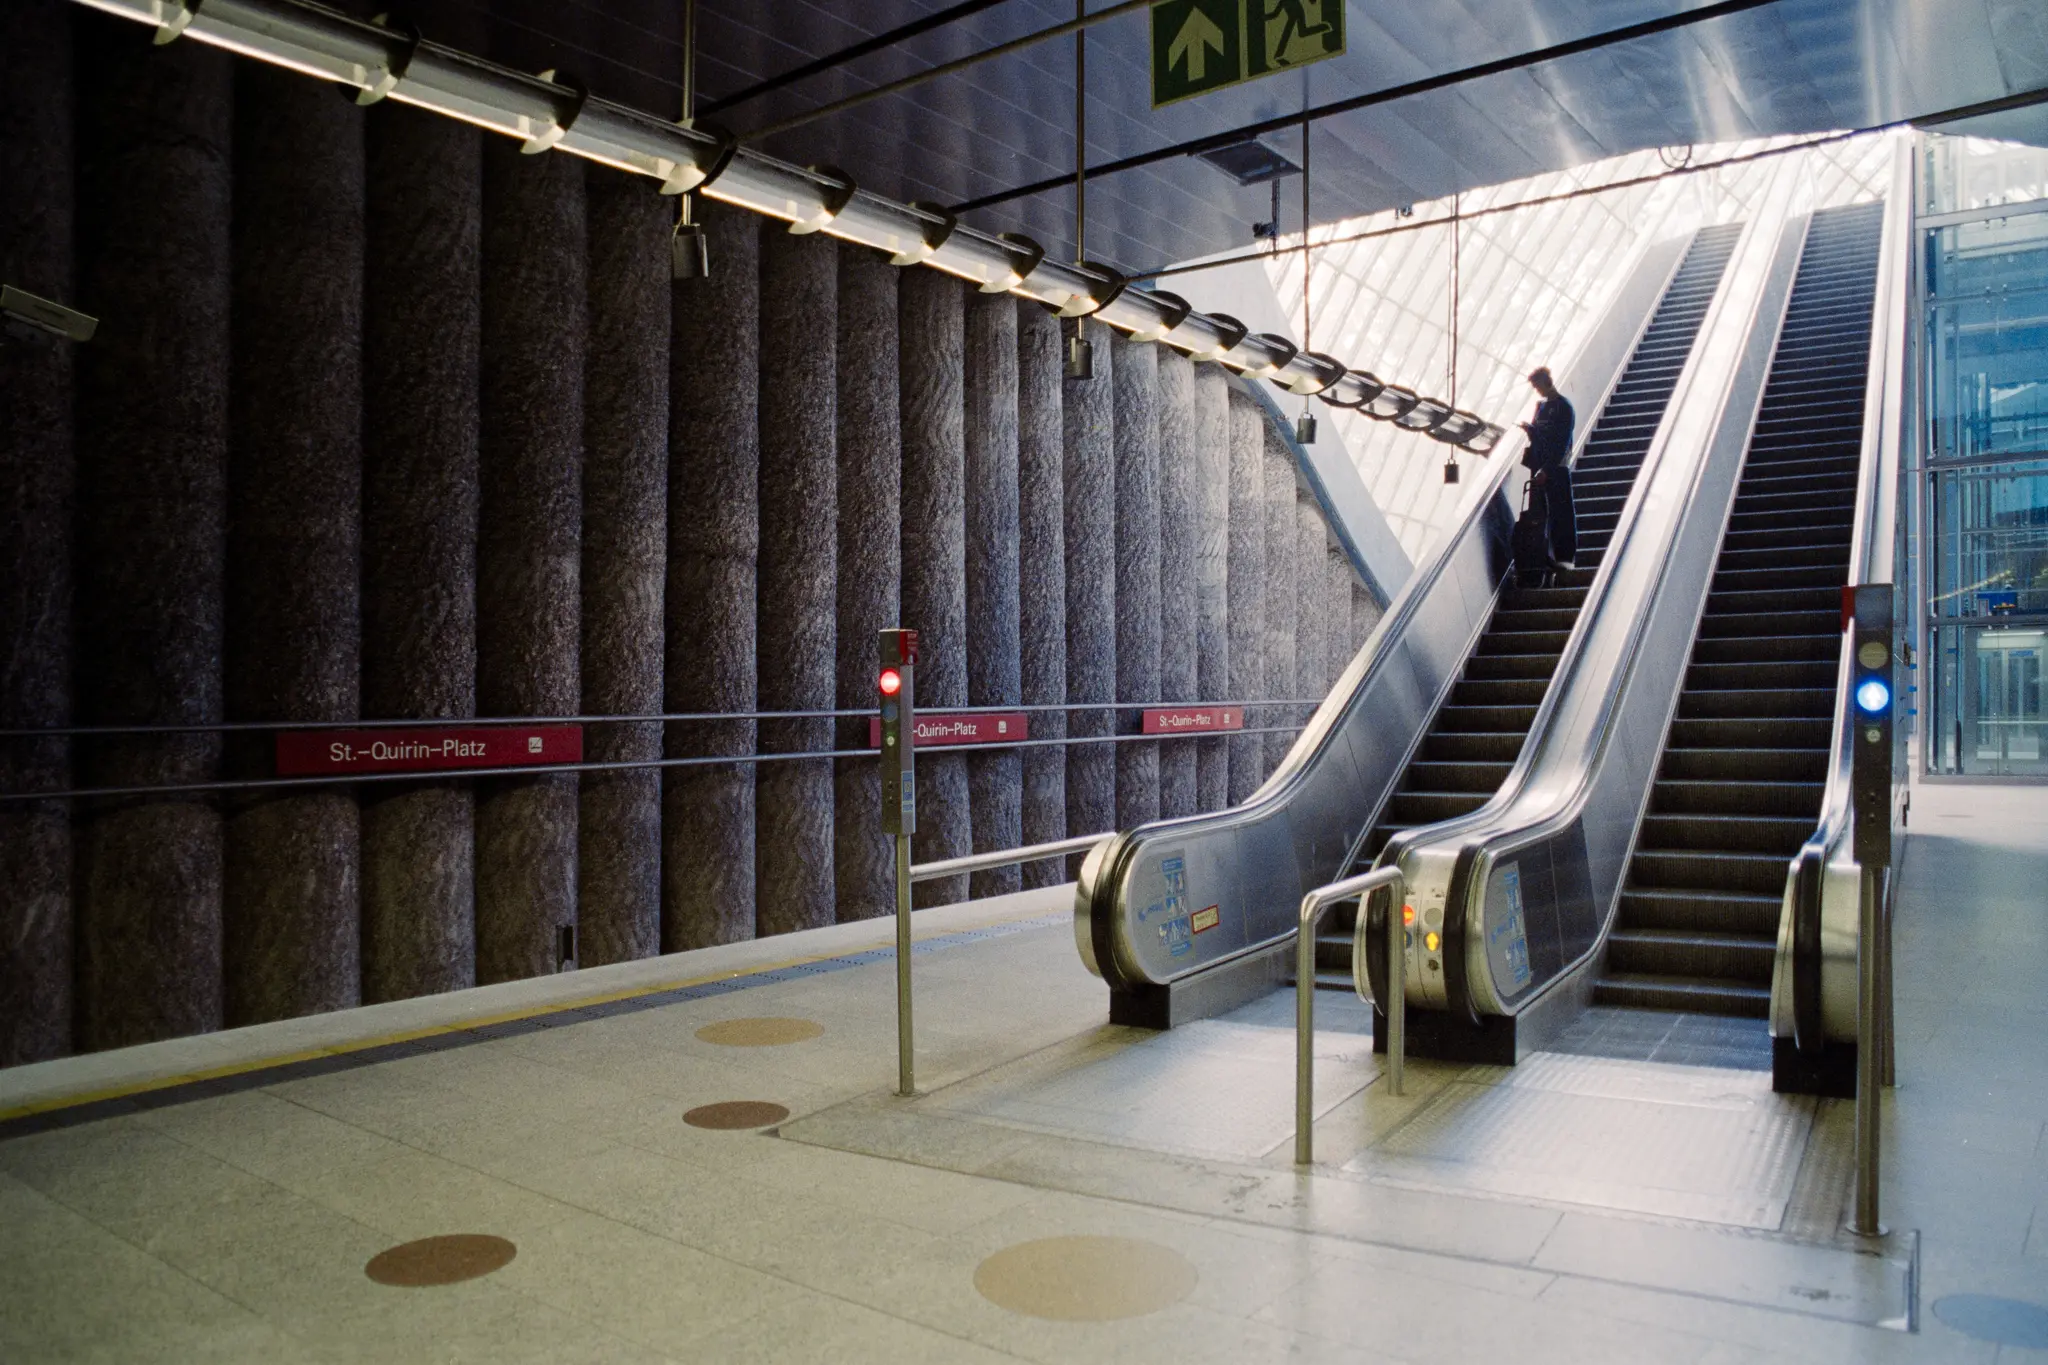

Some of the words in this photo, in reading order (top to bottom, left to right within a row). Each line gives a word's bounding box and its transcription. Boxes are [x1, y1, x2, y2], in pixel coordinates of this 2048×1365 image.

[1159, 714, 1211, 727] St.-Quirin-Platz
[912, 722, 977, 737] -Quirin-Platz
[329, 739, 486, 762] St.-Quirin-Platz
